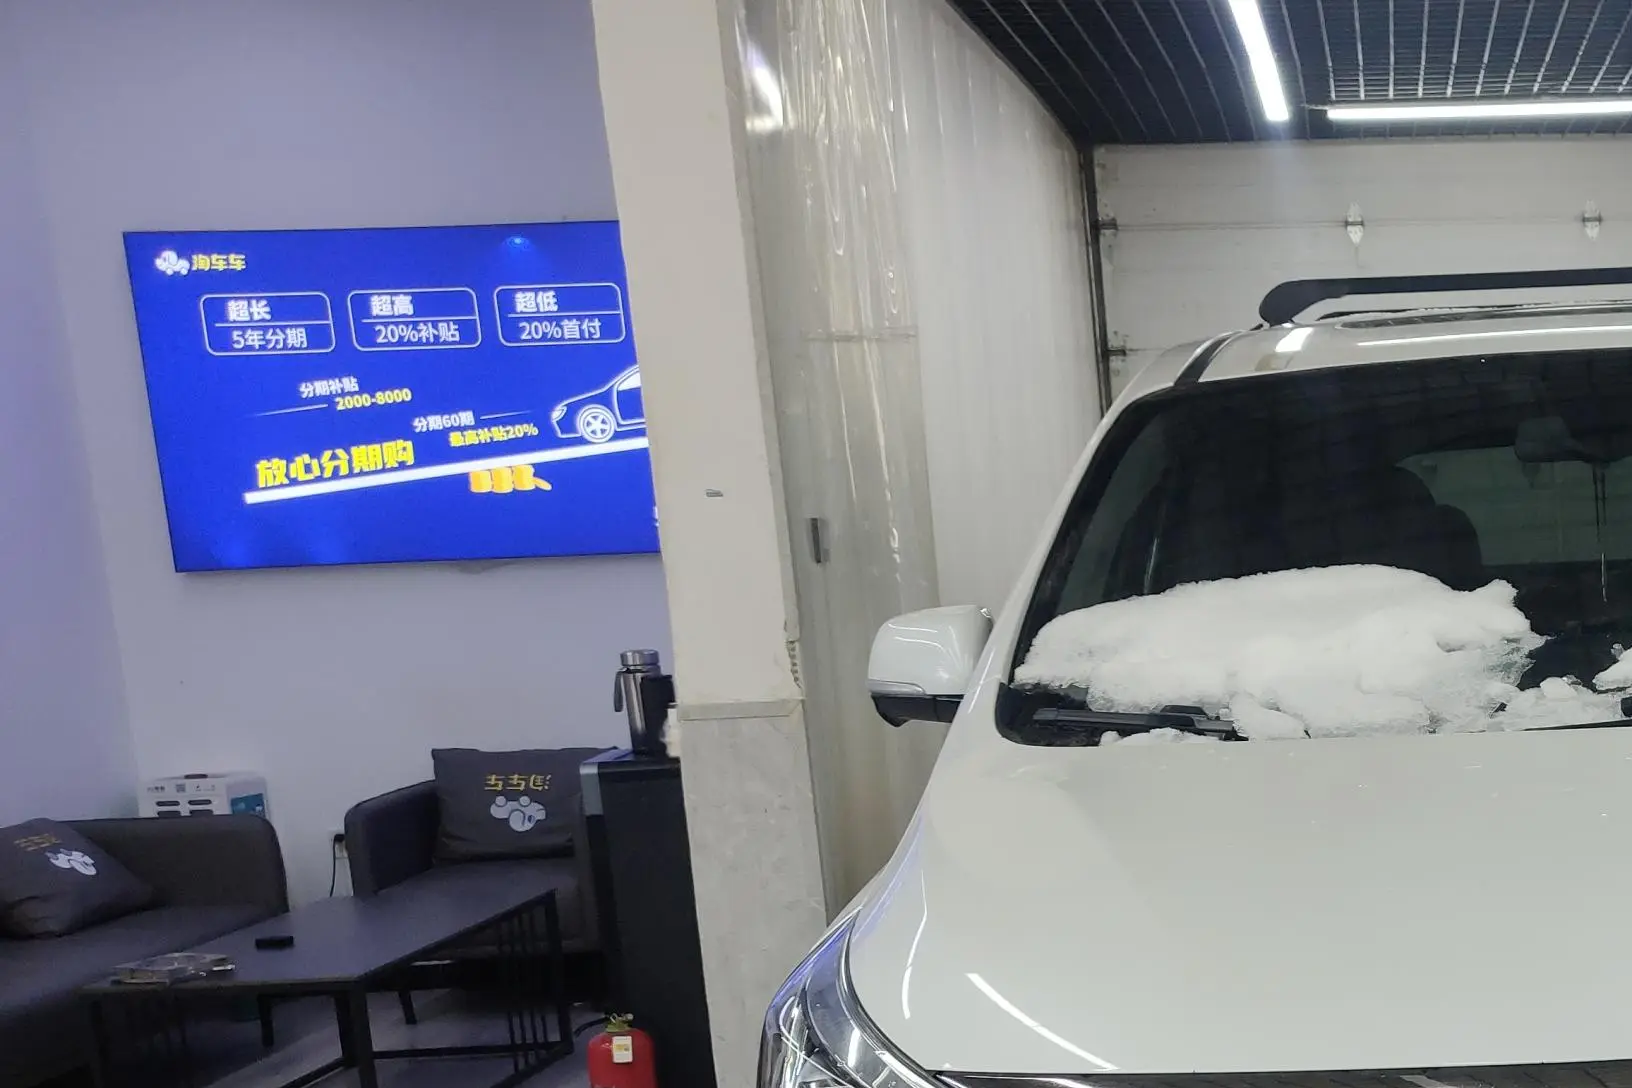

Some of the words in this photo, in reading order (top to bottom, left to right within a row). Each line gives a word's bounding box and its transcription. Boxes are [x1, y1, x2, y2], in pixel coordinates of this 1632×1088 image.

[227, 300, 272, 322] 超长
[370, 294, 414, 317] 超高
[515, 290, 558, 313] 超低
[232, 327, 308, 350] 5年分期
[375, 321, 460, 343] 20%补贴
[519, 318, 601, 340] 20%首付
[299, 376, 359, 398] 分期补贴
[335, 388, 412, 411] 2000-8000
[412, 410, 475, 433] 分期60期
[256, 439, 415, 488] 放心分期购
